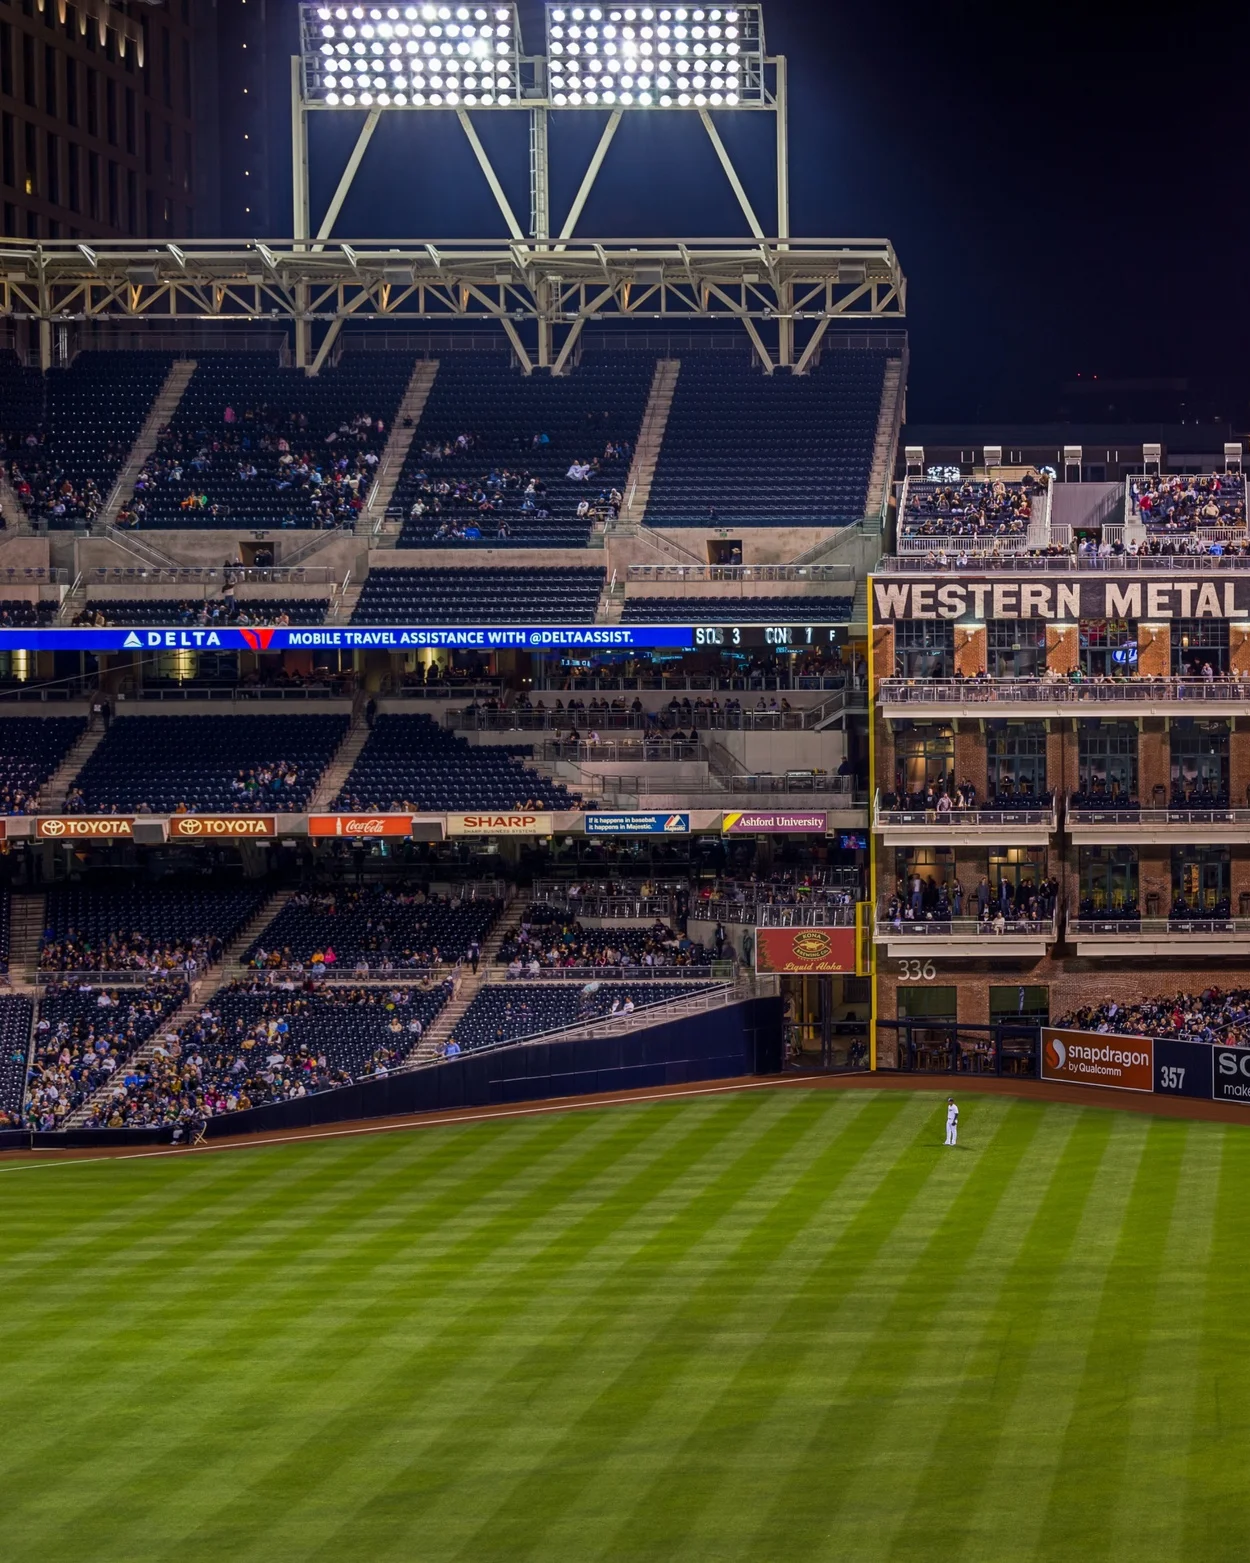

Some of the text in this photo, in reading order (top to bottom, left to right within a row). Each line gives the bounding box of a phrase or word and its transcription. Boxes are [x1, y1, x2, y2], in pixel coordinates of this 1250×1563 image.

[874, 583, 1080, 618] WESTERN
[1106, 582, 1248, 618] METAL
[148, 632, 221, 646] DELTA
[289, 631, 634, 644] MOBILE TRAVEL ASSISTANCE WITH @DELTAASSIST.
[733, 628, 835, 644] 3 F
[67, 821, 131, 833] TOYOTA
[204, 820, 267, 833] TOYOTA
[464, 817, 536, 827] SHARP
[739, 817, 824, 829] Ashford University
[783, 962, 841, 972] Liquid Aloha
[897, 959, 936, 981] 336
[1068, 1044, 1149, 1067] snapdragon
[1069, 1063, 1122, 1077] by Qualcomm
[1160, 1066, 1185, 1089] 357
